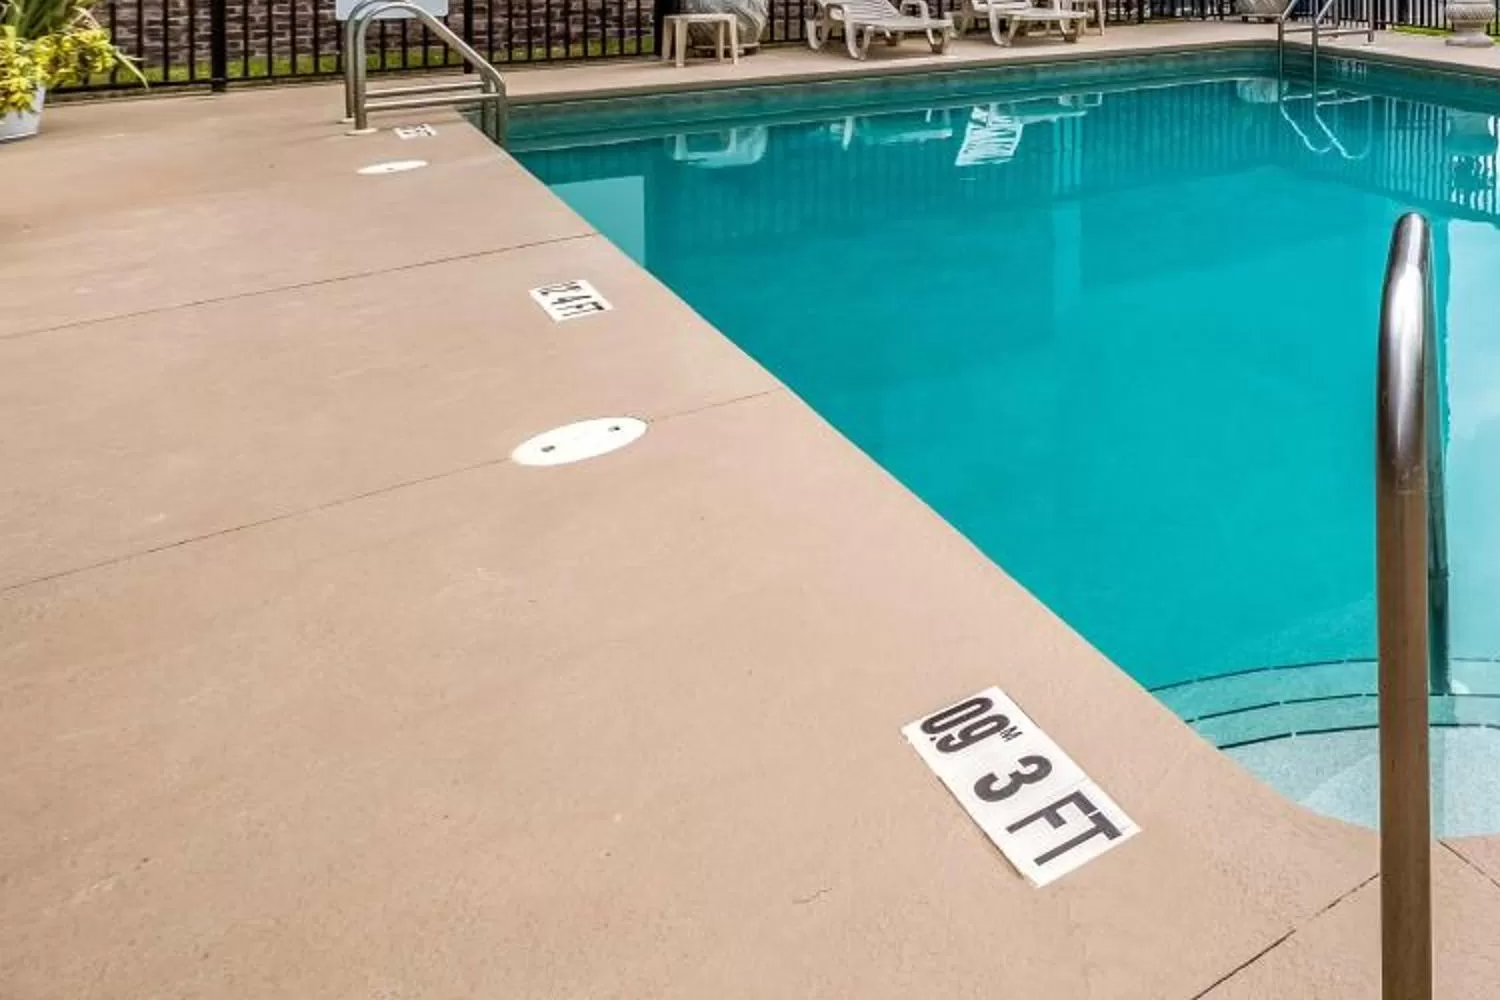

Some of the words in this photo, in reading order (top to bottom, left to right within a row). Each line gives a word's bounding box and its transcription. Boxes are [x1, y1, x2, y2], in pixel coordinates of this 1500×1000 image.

[555, 301, 606, 317] FT
[973, 754, 1053, 803] 3
[1005, 790, 1123, 867] FT
